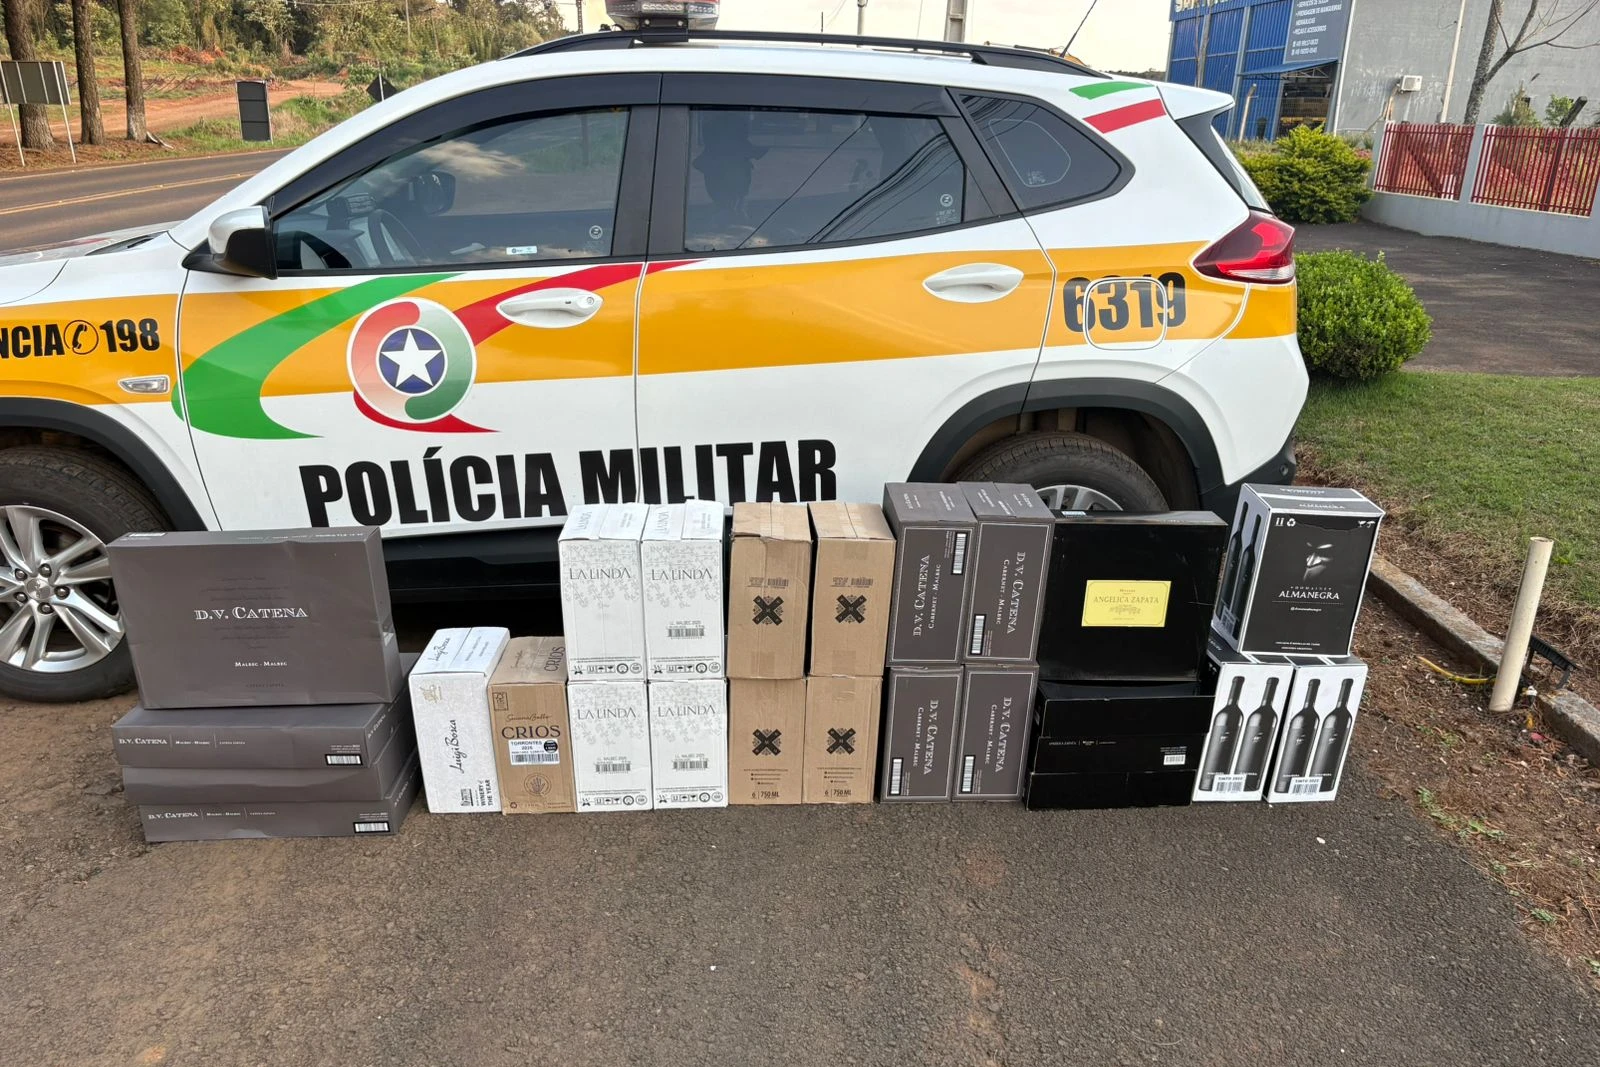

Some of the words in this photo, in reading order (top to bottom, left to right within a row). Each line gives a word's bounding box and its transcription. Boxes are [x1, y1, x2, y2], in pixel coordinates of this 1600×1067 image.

[1063, 272, 1187, 332] 6319
[100, 318, 160, 352] 198
[299, 446, 567, 528] POLÍCIA
[579, 439, 837, 505] MILITAR
[914, 554, 930, 610] CATENA
[1278, 590, 1340, 600] ALMANEGRA
[194, 609, 229, 620] D.V.
[231, 606, 308, 619] CATENA
[1007, 579, 1024, 634] CATENA
[544, 646, 566, 672] CRIOS
[135, 737, 168, 745] CATENA
[444, 719, 459, 747] Bosca
[501, 725, 561, 740] CRIOS
[995, 722, 1010, 772] CATENA
[448, 747, 468, 774] Luigi
[923, 724, 938, 775] CATENA
